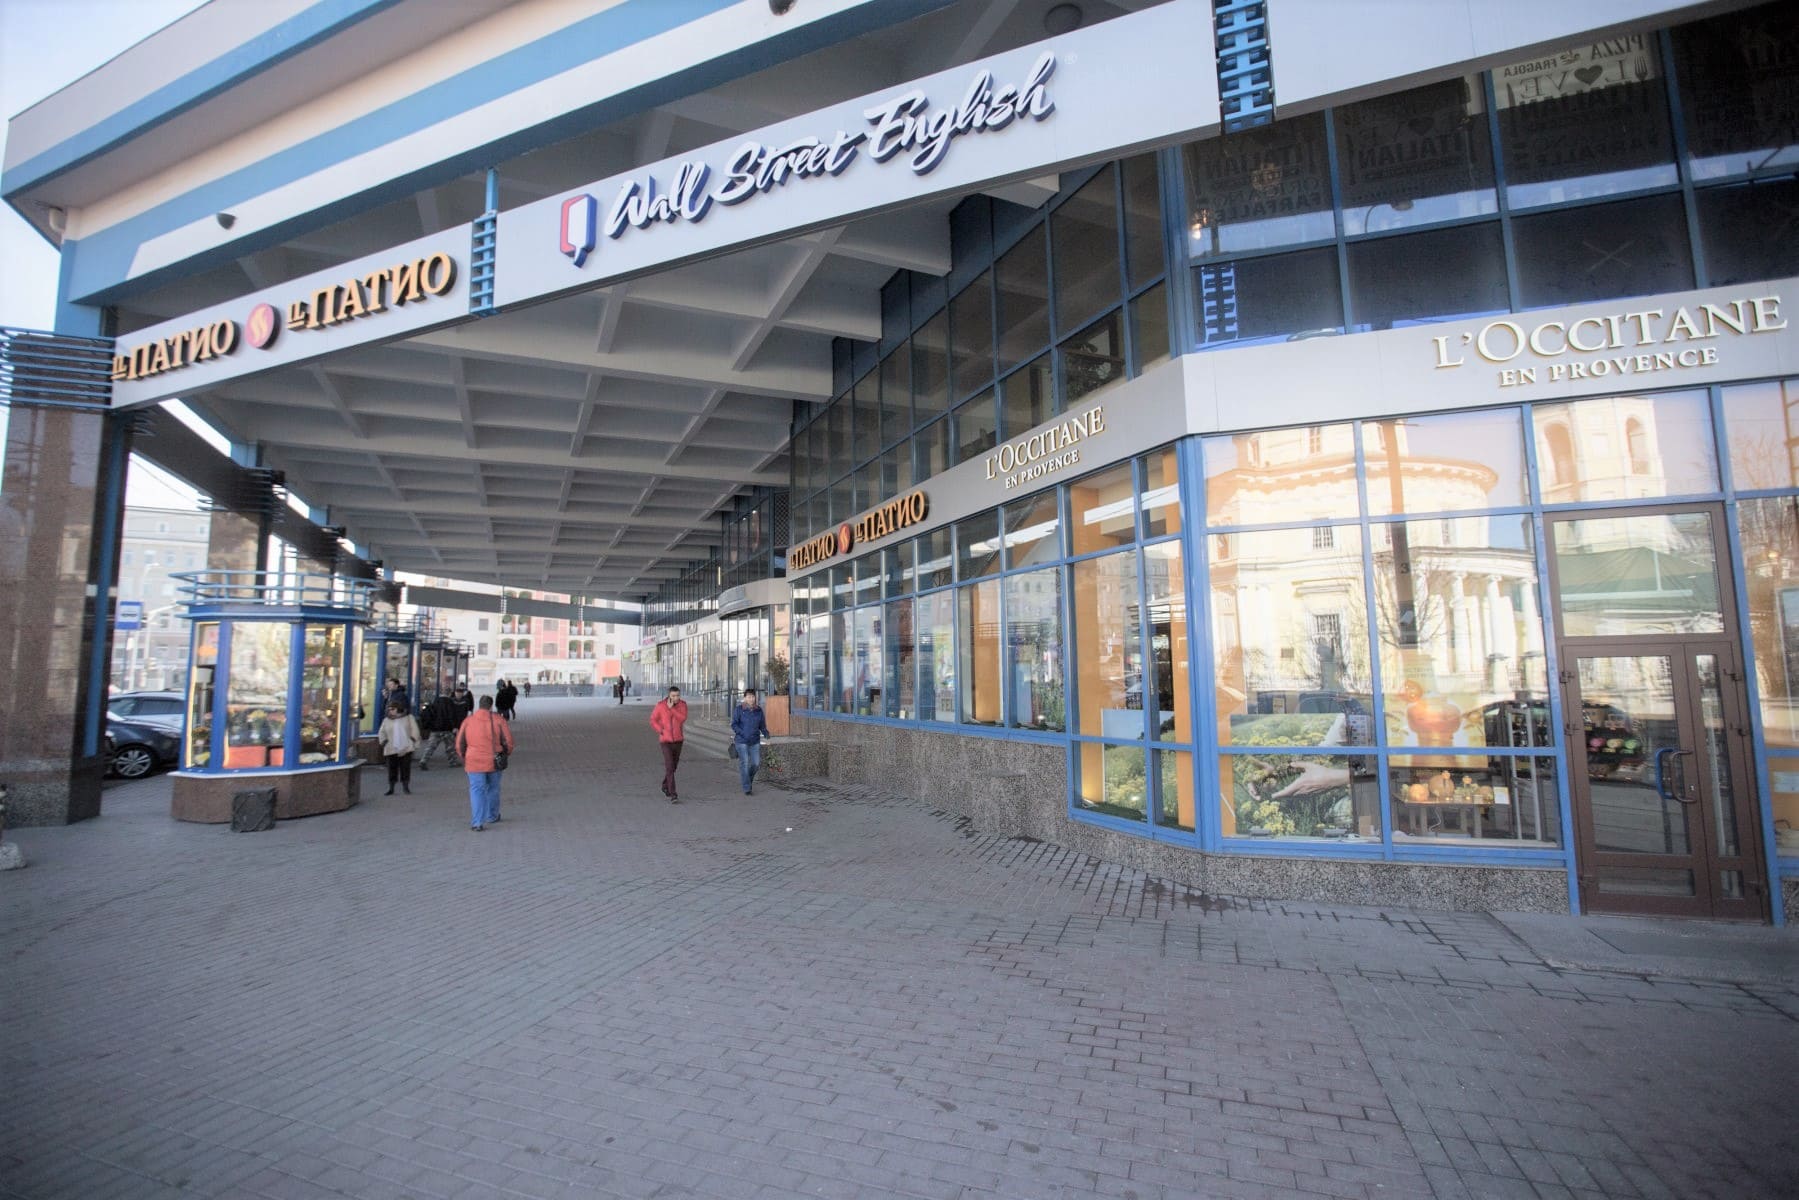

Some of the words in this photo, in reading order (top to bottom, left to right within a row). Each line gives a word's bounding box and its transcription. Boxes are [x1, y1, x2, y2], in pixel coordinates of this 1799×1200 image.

[606, 161, 711, 239] Wall
[711, 131, 864, 204] Street
[864, 51, 1056, 176] English
[1432, 295, 1788, 368] L'OCCITANE
[1499, 367, 1538, 387] EN
[1549, 347, 1720, 380] PROVENCE
[985, 406, 1105, 481] L'OCCITANE
[1005, 474, 1020, 489] EN
[1021, 448, 1080, 484] PROVENCE
